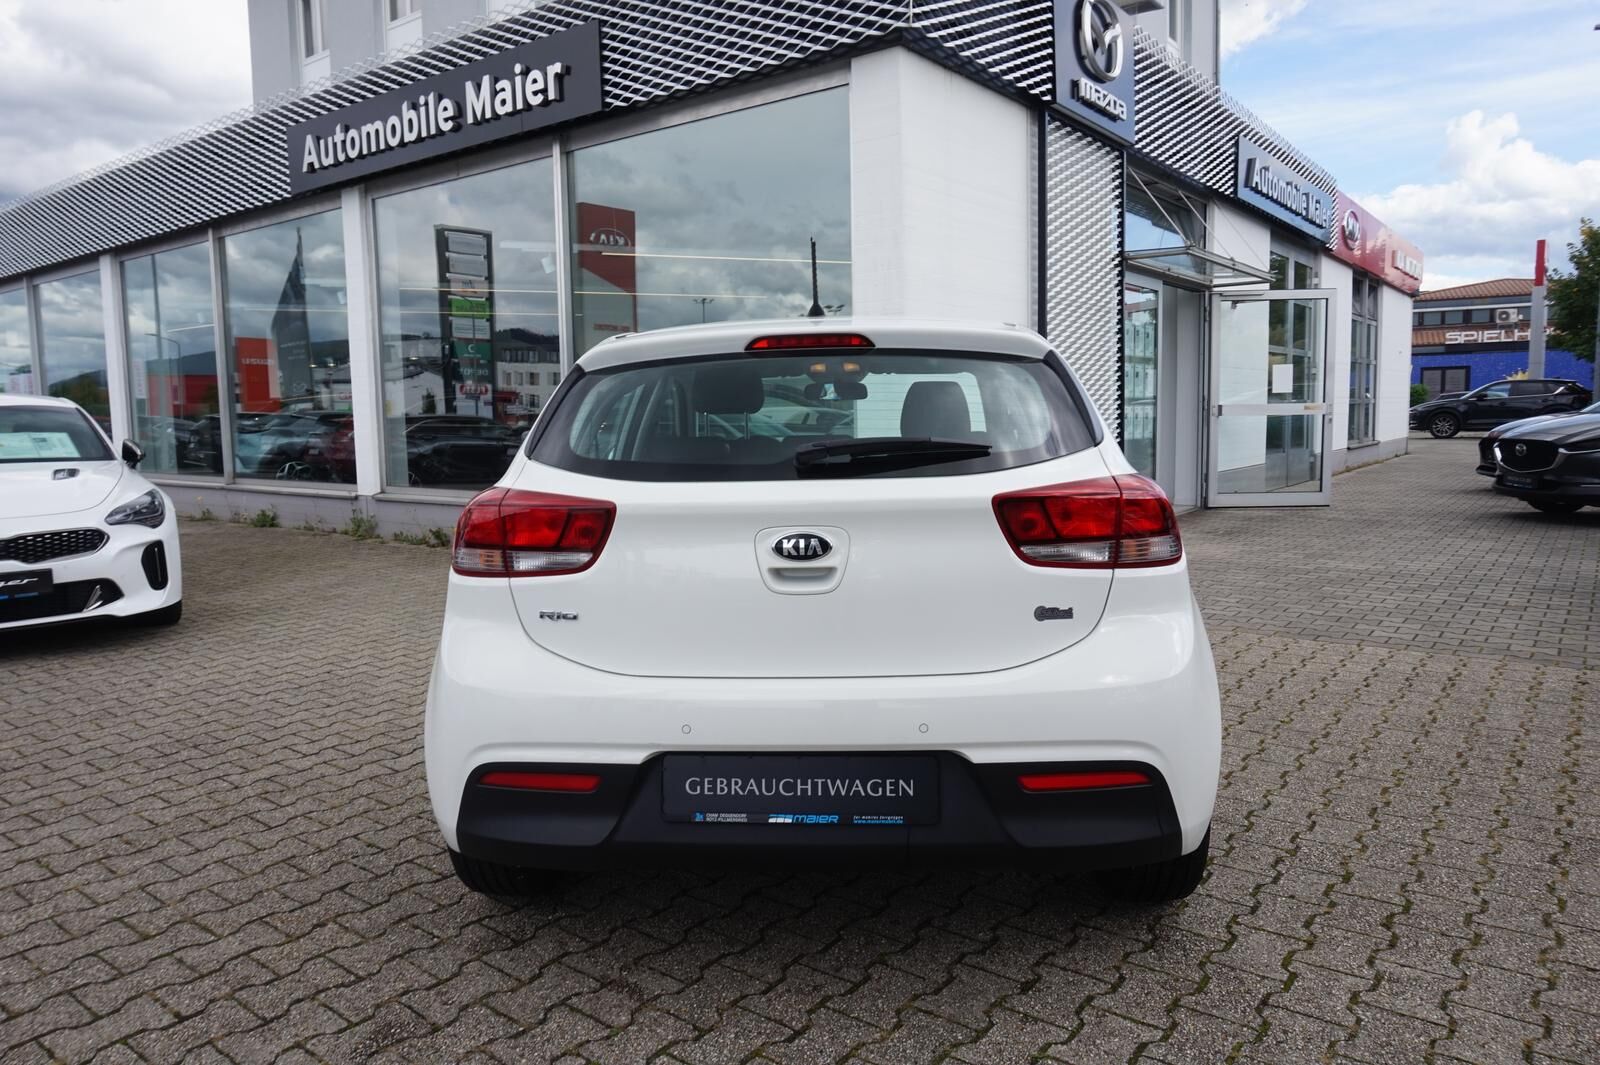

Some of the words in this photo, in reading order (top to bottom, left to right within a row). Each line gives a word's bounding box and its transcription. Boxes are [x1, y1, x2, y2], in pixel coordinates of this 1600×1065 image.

[302, 91, 454, 173] Automobile
[464, 61, 564, 125] Maier
[1079, 77, 1127, 120] mazda
[1252, 157, 1307, 217] Automobile
[782, 538, 823, 556] KIA
[685, 777, 914, 797] GEBRAUCHTWAGEN
